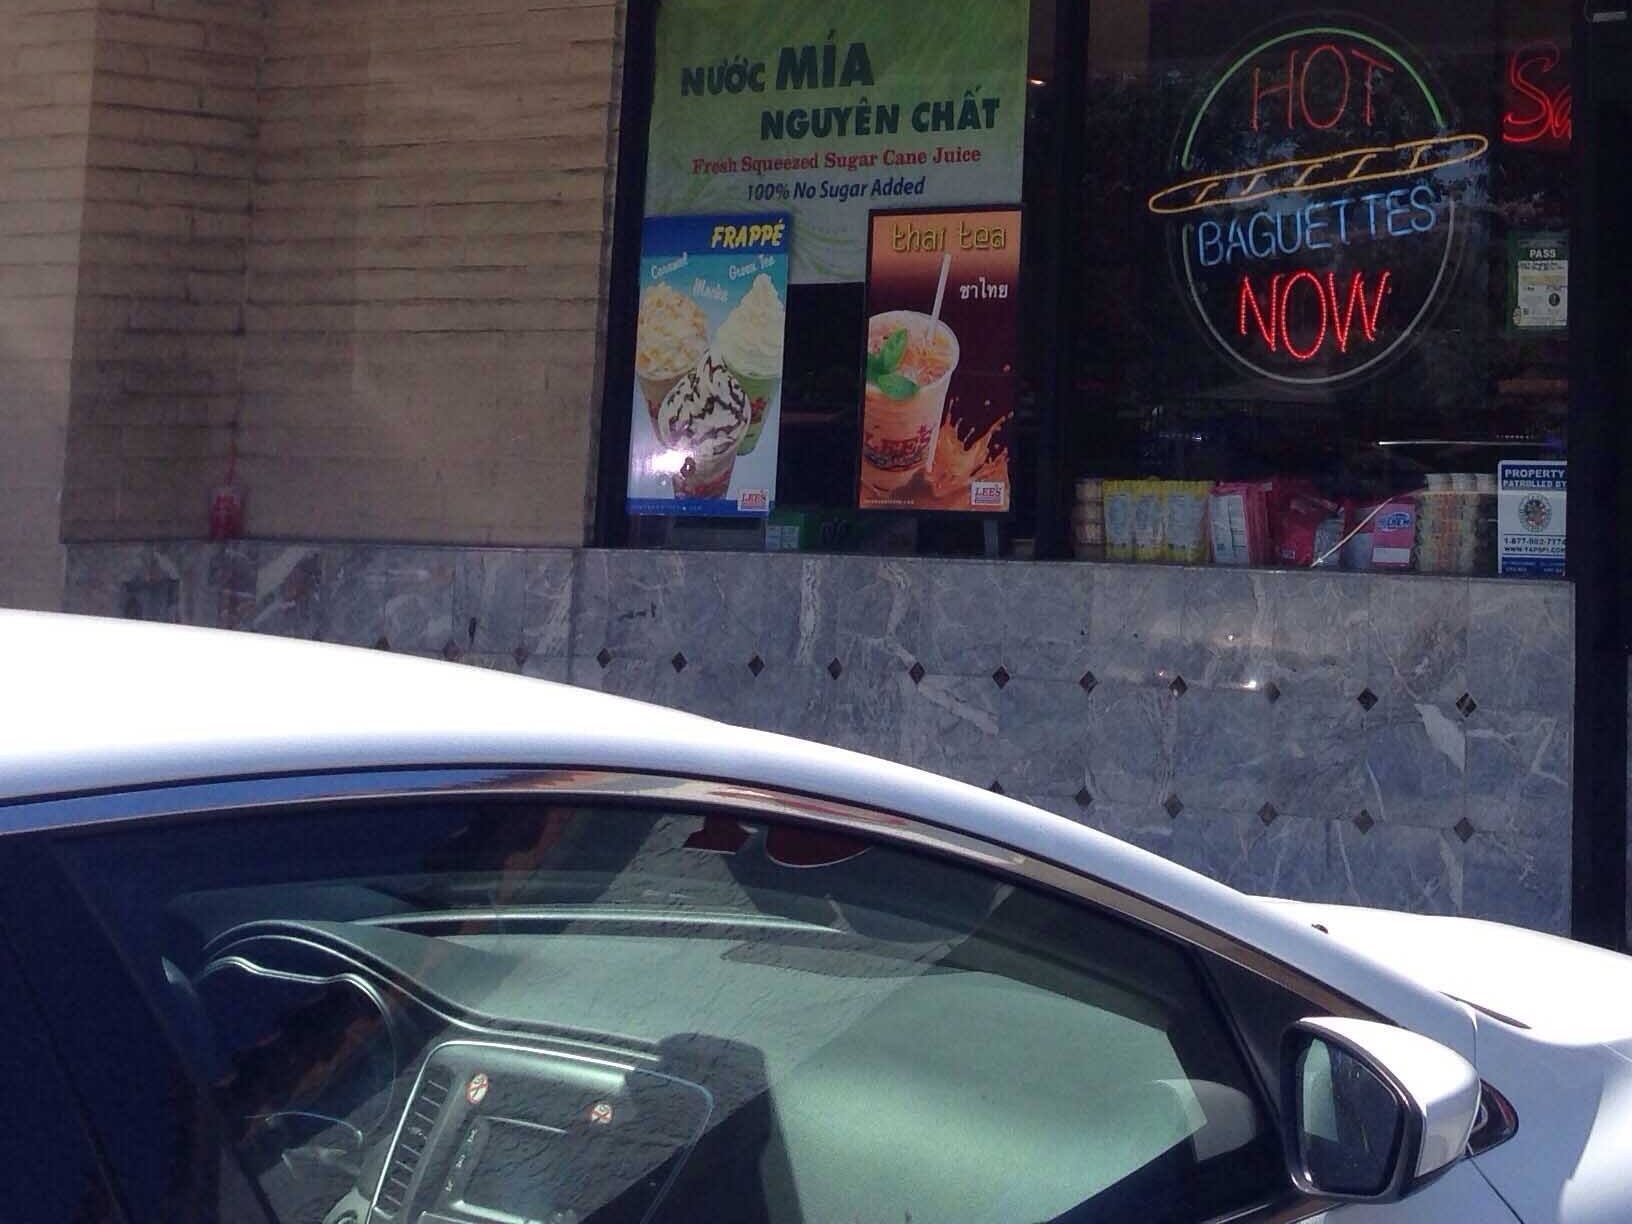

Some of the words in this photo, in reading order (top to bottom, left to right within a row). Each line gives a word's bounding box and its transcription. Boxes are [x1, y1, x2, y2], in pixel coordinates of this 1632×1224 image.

[681, 55, 766, 96] NƯỚC
[1249, 44, 1394, 132] HOT
[761, 97, 900, 141] NGUYÊN
[911, 84, 1000, 132] CHẤT
[692, 158, 738, 175] Fresh
[741, 152, 819, 176] Squeezed
[824, 151, 878, 172] Sugar
[883, 149, 927, 167] Cane
[932, 146, 981, 164] Juice
[748, 183, 790, 202] 100%
[793, 180, 816, 200] No
[819, 180, 868, 203] Sugar
[871, 176, 926, 197] Added
[710, 218, 785, 249] FRAPPÉ
[891, 222, 947, 253] thai
[959, 221, 1007, 251] tea
[1198, 184, 1441, 266] BAGUETTES
[1529, 248, 1557, 259] PASS
[959, 276, 1009, 300] ชาไทย
[1240, 269, 1392, 360] NOW
[1503, 479, 1553, 487] PATROLLED
[1504, 468, 1566, 478] PROPERTY
